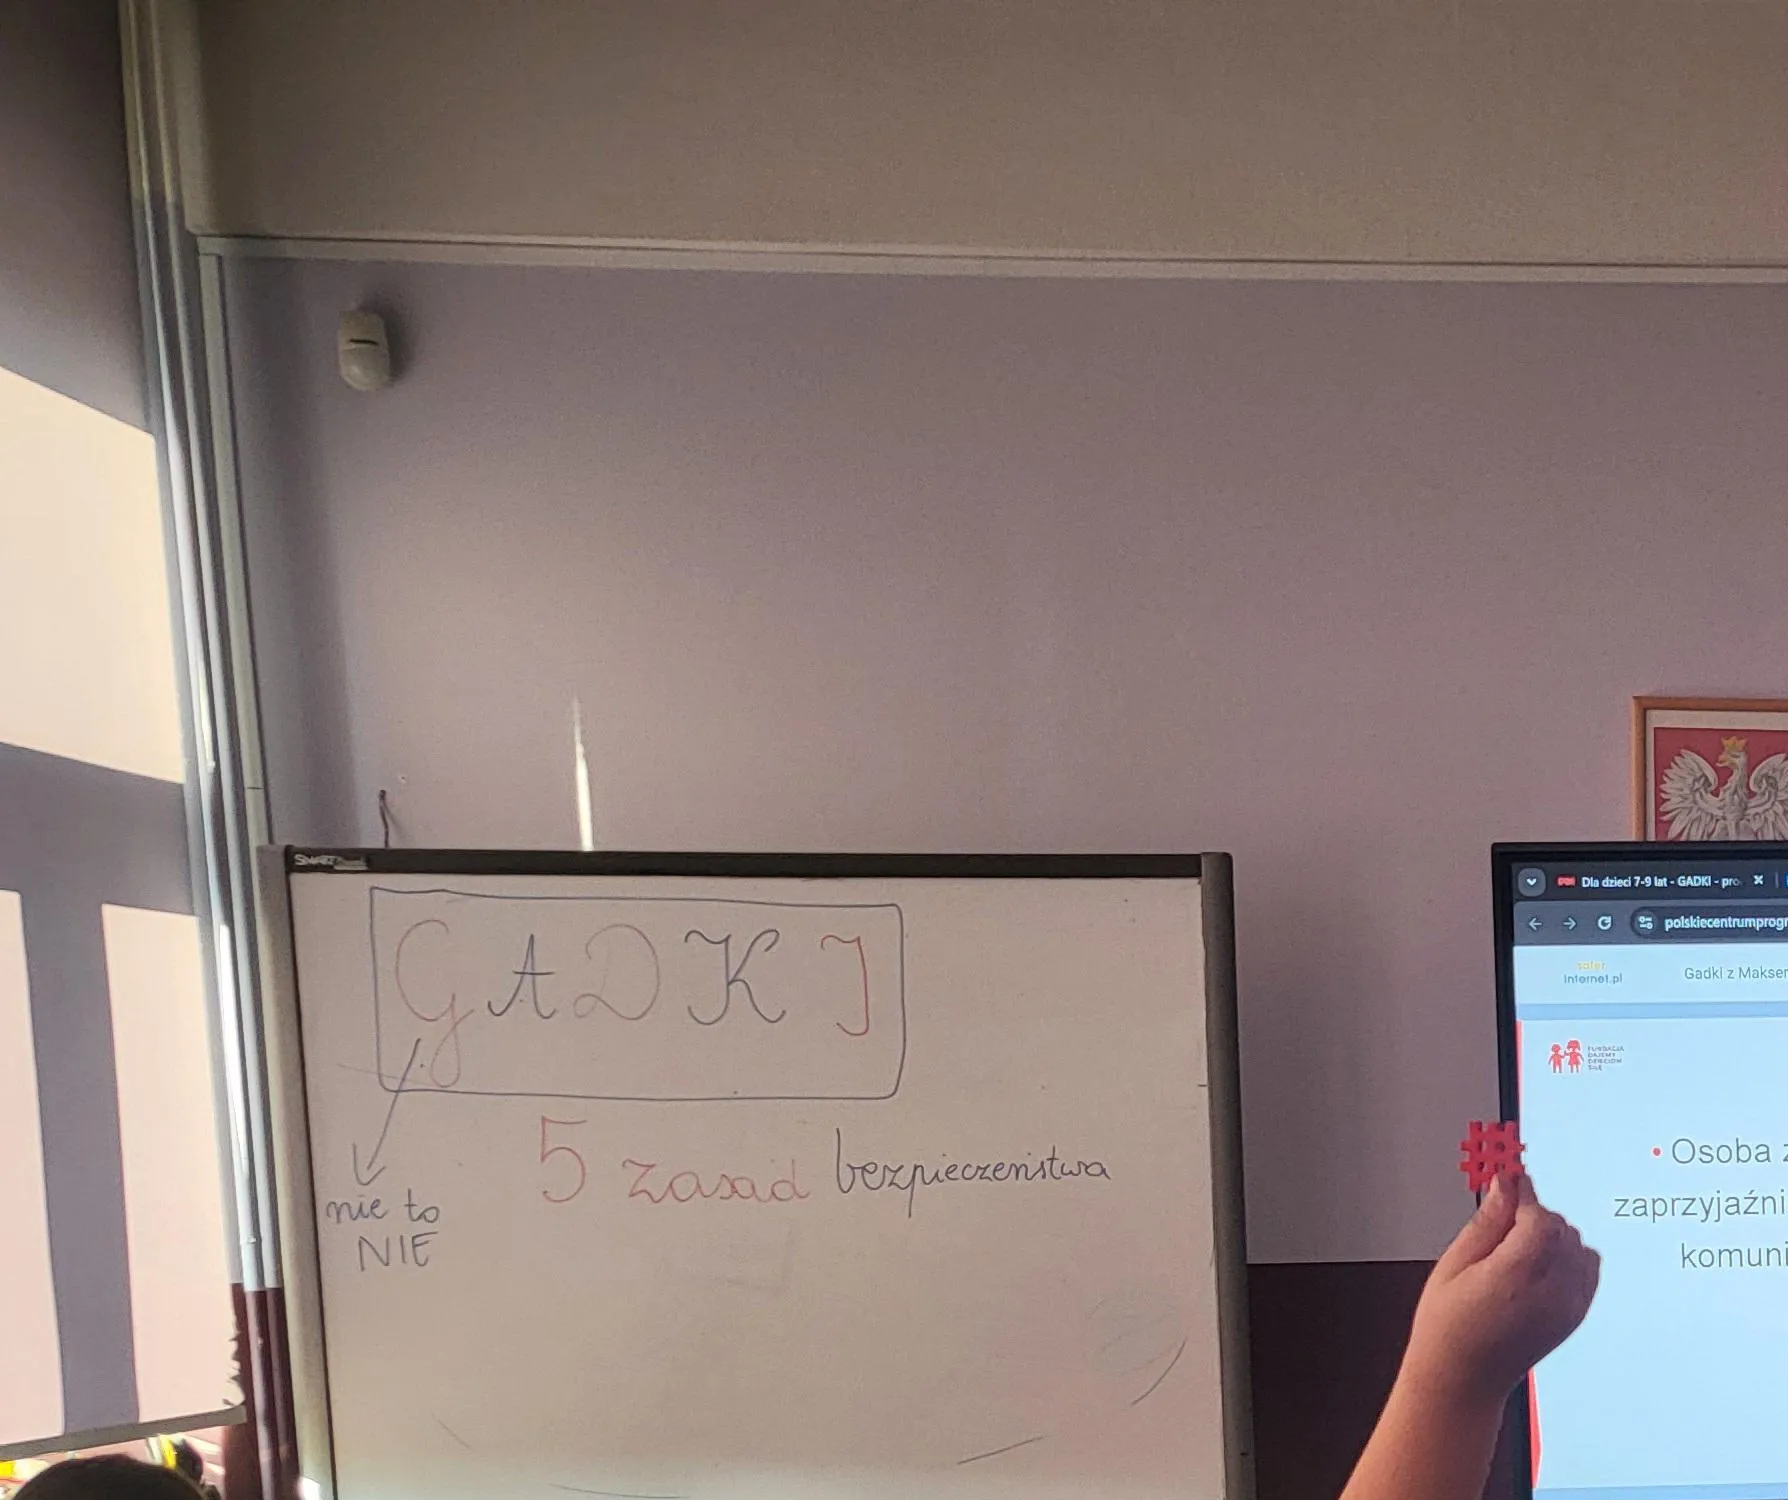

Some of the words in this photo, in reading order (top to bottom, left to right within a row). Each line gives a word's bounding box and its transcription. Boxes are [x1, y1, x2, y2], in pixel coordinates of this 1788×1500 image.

[1581, 876, 1600, 888] Dla
[1602, 876, 1632, 887] dzieci
[1634, 875, 1651, 887] 7-9
[1654, 876, 1668, 887] lat
[1677, 875, 1712, 887] GADKI
[1564, 973, 1622, 984] internet.pl
[1684, 967, 1723, 980] Gadki
[1727, 970, 1734, 979] z
[1671, 1137, 1771, 1165] Osoba
[538, 1117, 589, 1203] 5
[621, 1155, 811, 1205] zasad
[835, 1127, 1111, 1218] bezpieczeństwa
[325, 1199, 390, 1225] nie
[404, 1189, 440, 1225] to
[356, 1232, 436, 1272] NIE
